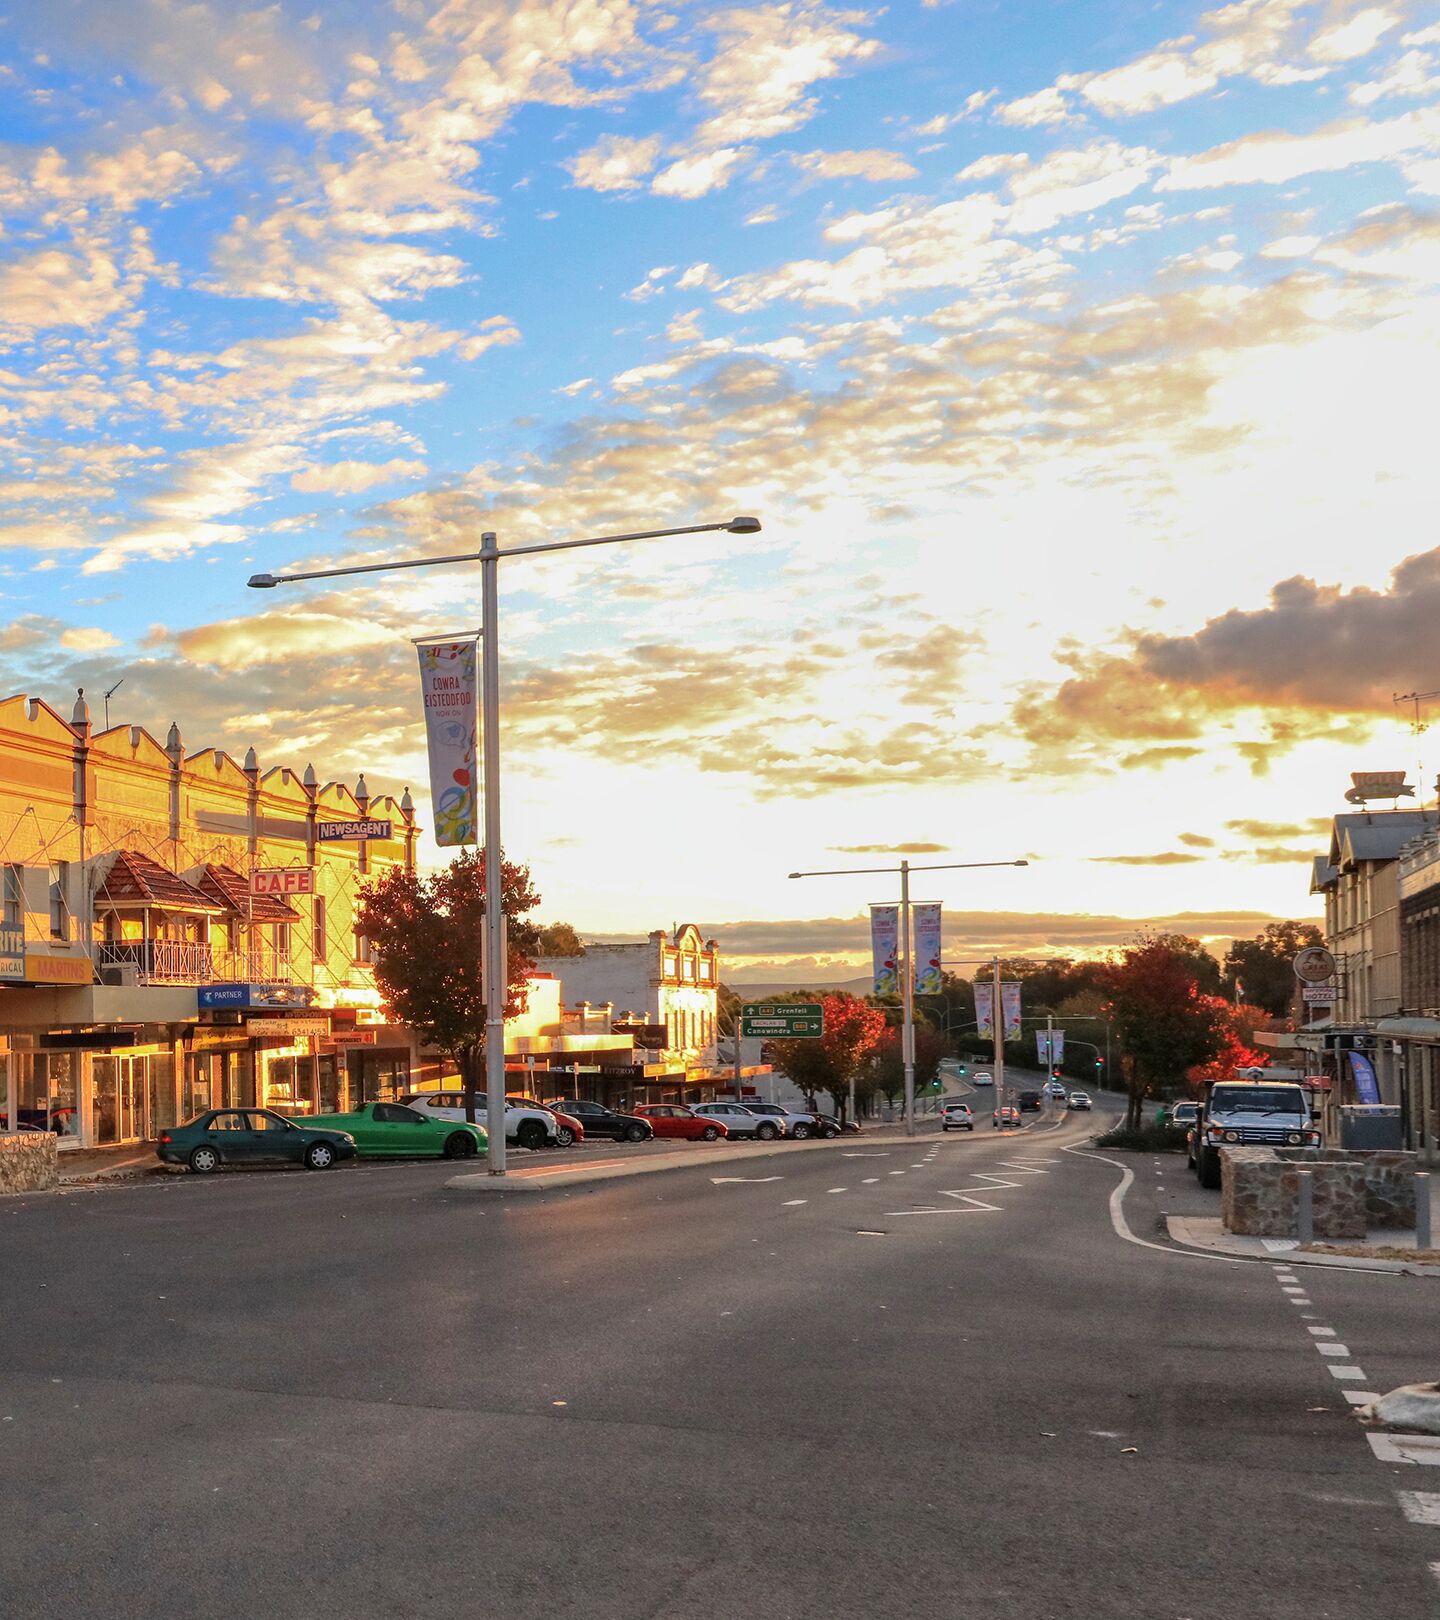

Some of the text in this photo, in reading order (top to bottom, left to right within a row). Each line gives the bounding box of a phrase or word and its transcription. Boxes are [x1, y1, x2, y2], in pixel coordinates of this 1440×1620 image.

[433, 676, 460, 690] COWRA
[320, 822, 389, 838] NEWSAGENT
[255, 873, 309, 892] CAFE
[38, 960, 85, 979] MARTINS
[214, 991, 242, 999] PARTNER
